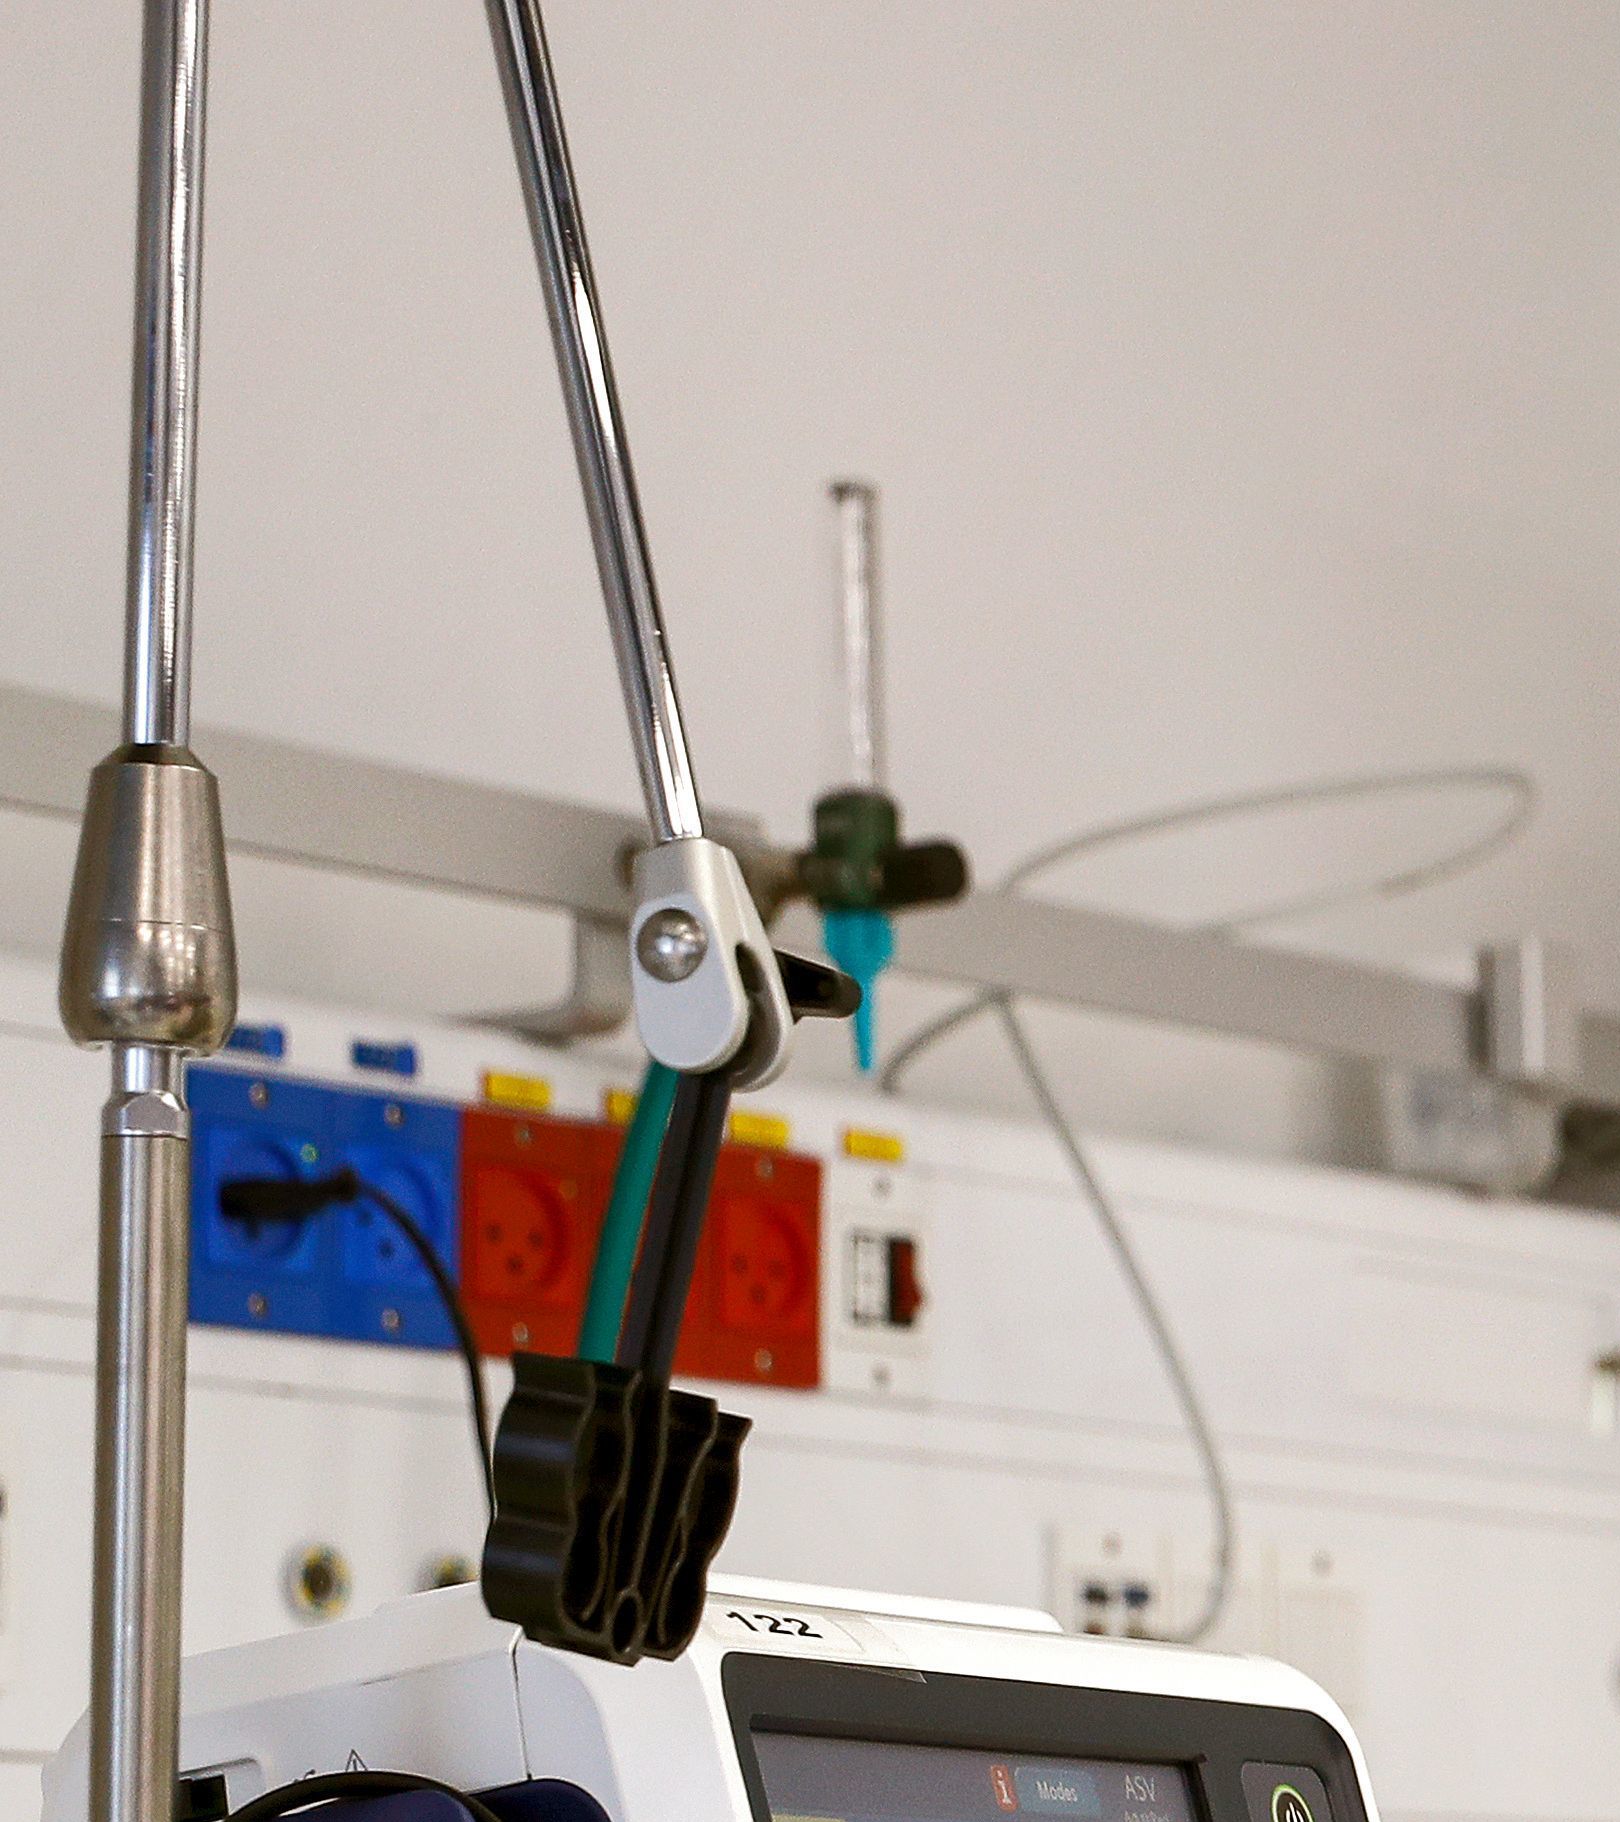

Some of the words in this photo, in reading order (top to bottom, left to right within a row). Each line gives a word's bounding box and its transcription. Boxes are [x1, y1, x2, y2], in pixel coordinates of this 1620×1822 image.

[727, 1611, 823, 1639] 122
[1036, 1780, 1078, 1802] Modes
[1125, 1775, 1157, 1802] ASV
